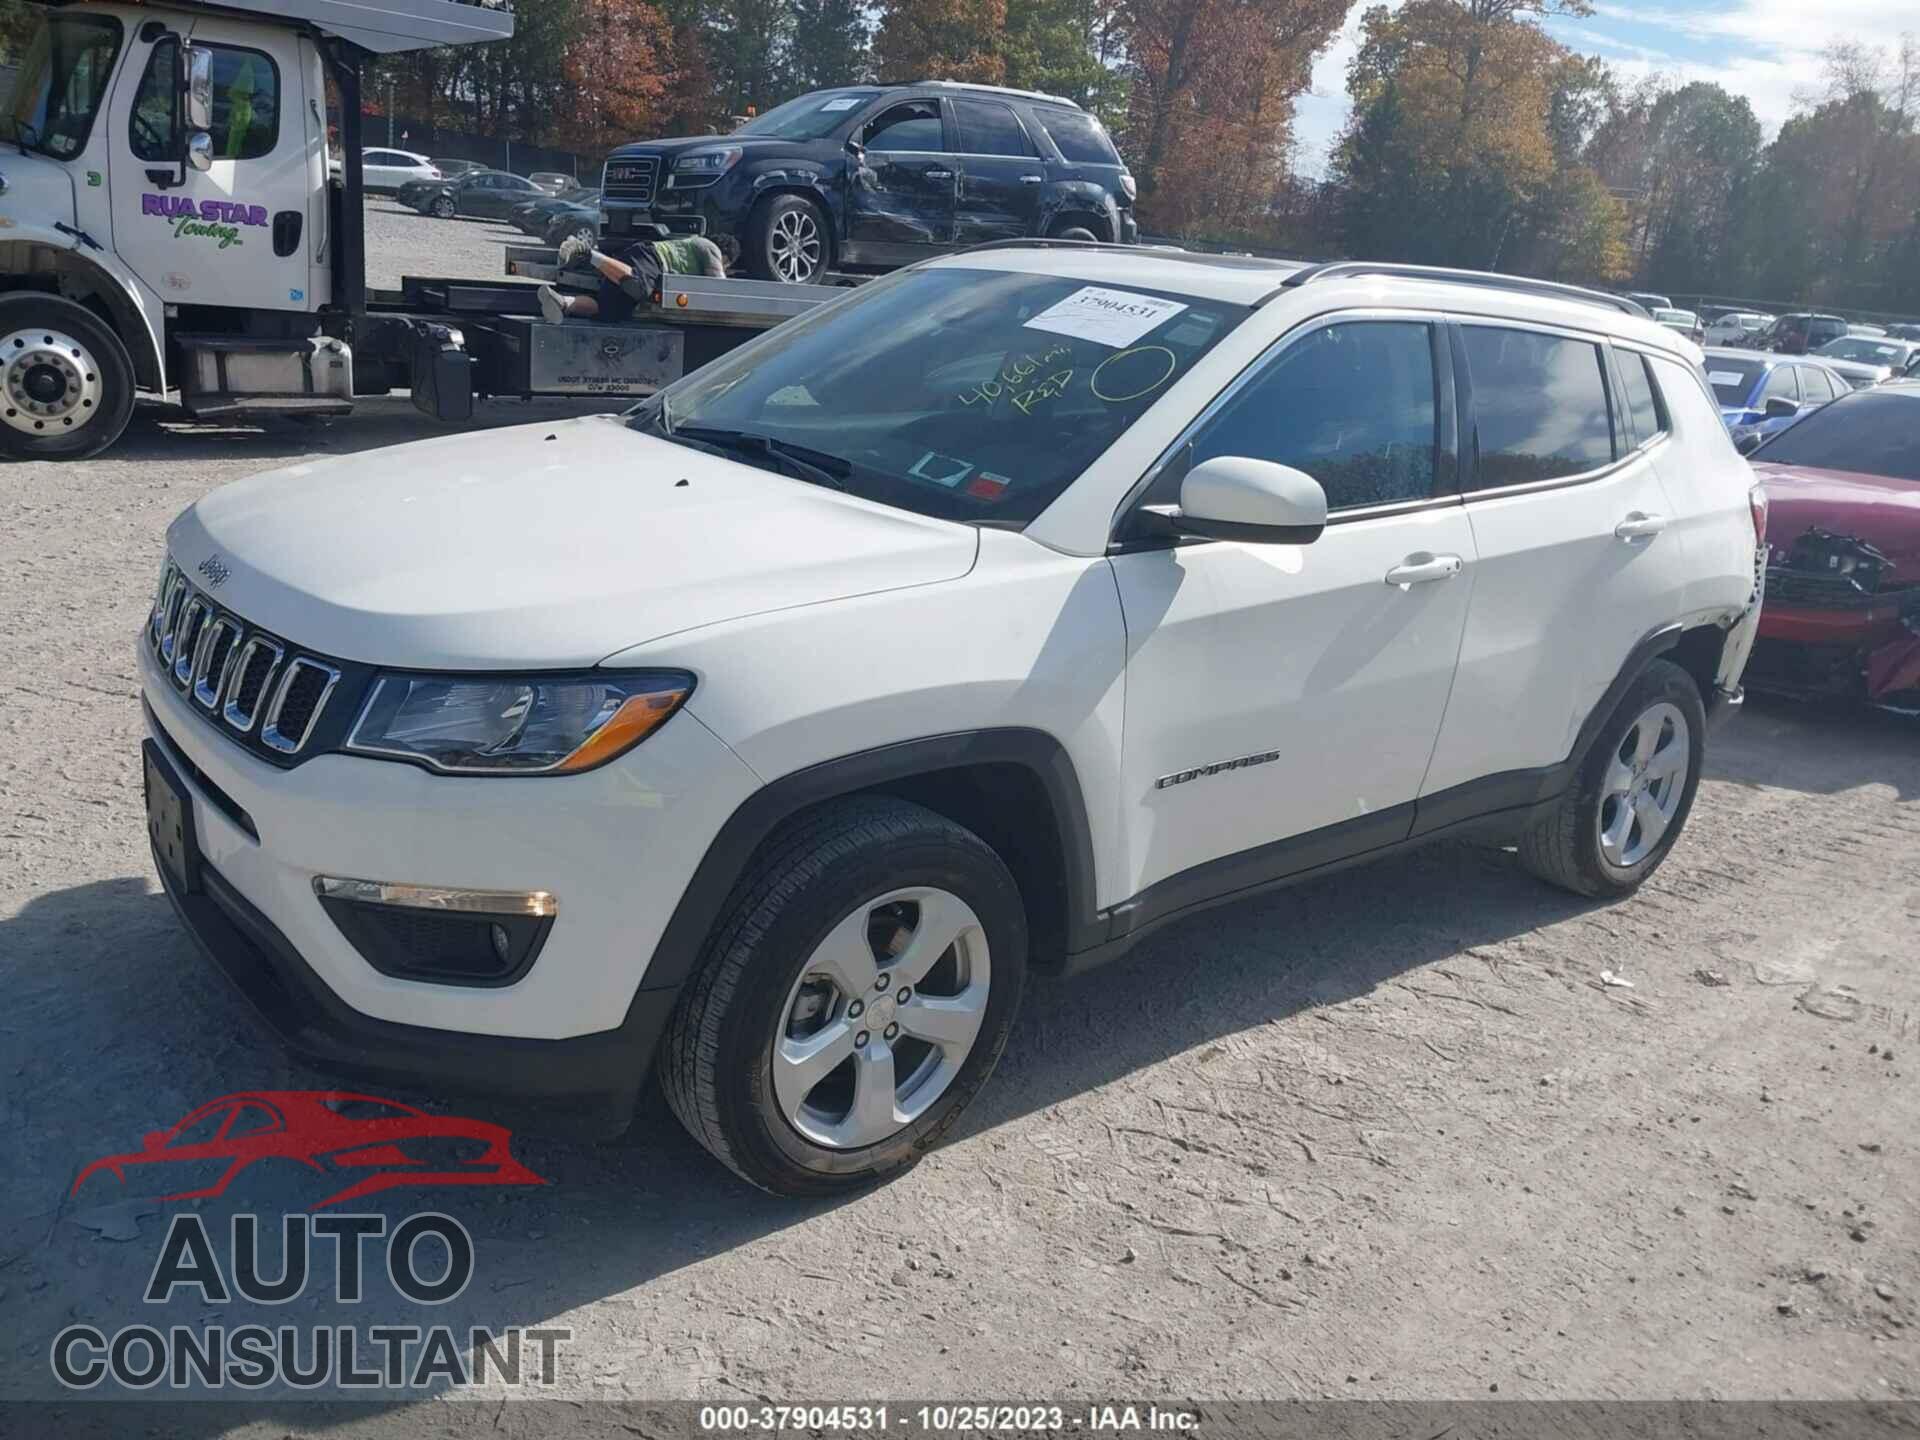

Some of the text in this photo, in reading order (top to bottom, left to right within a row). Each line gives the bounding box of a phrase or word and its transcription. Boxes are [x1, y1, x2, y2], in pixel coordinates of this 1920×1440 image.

[142, 193, 269, 227] RUA STAR
[168, 213, 239, 249] Towing
[198, 553, 231, 590] Jeep
[1154, 749, 1281, 790] COMPASS
